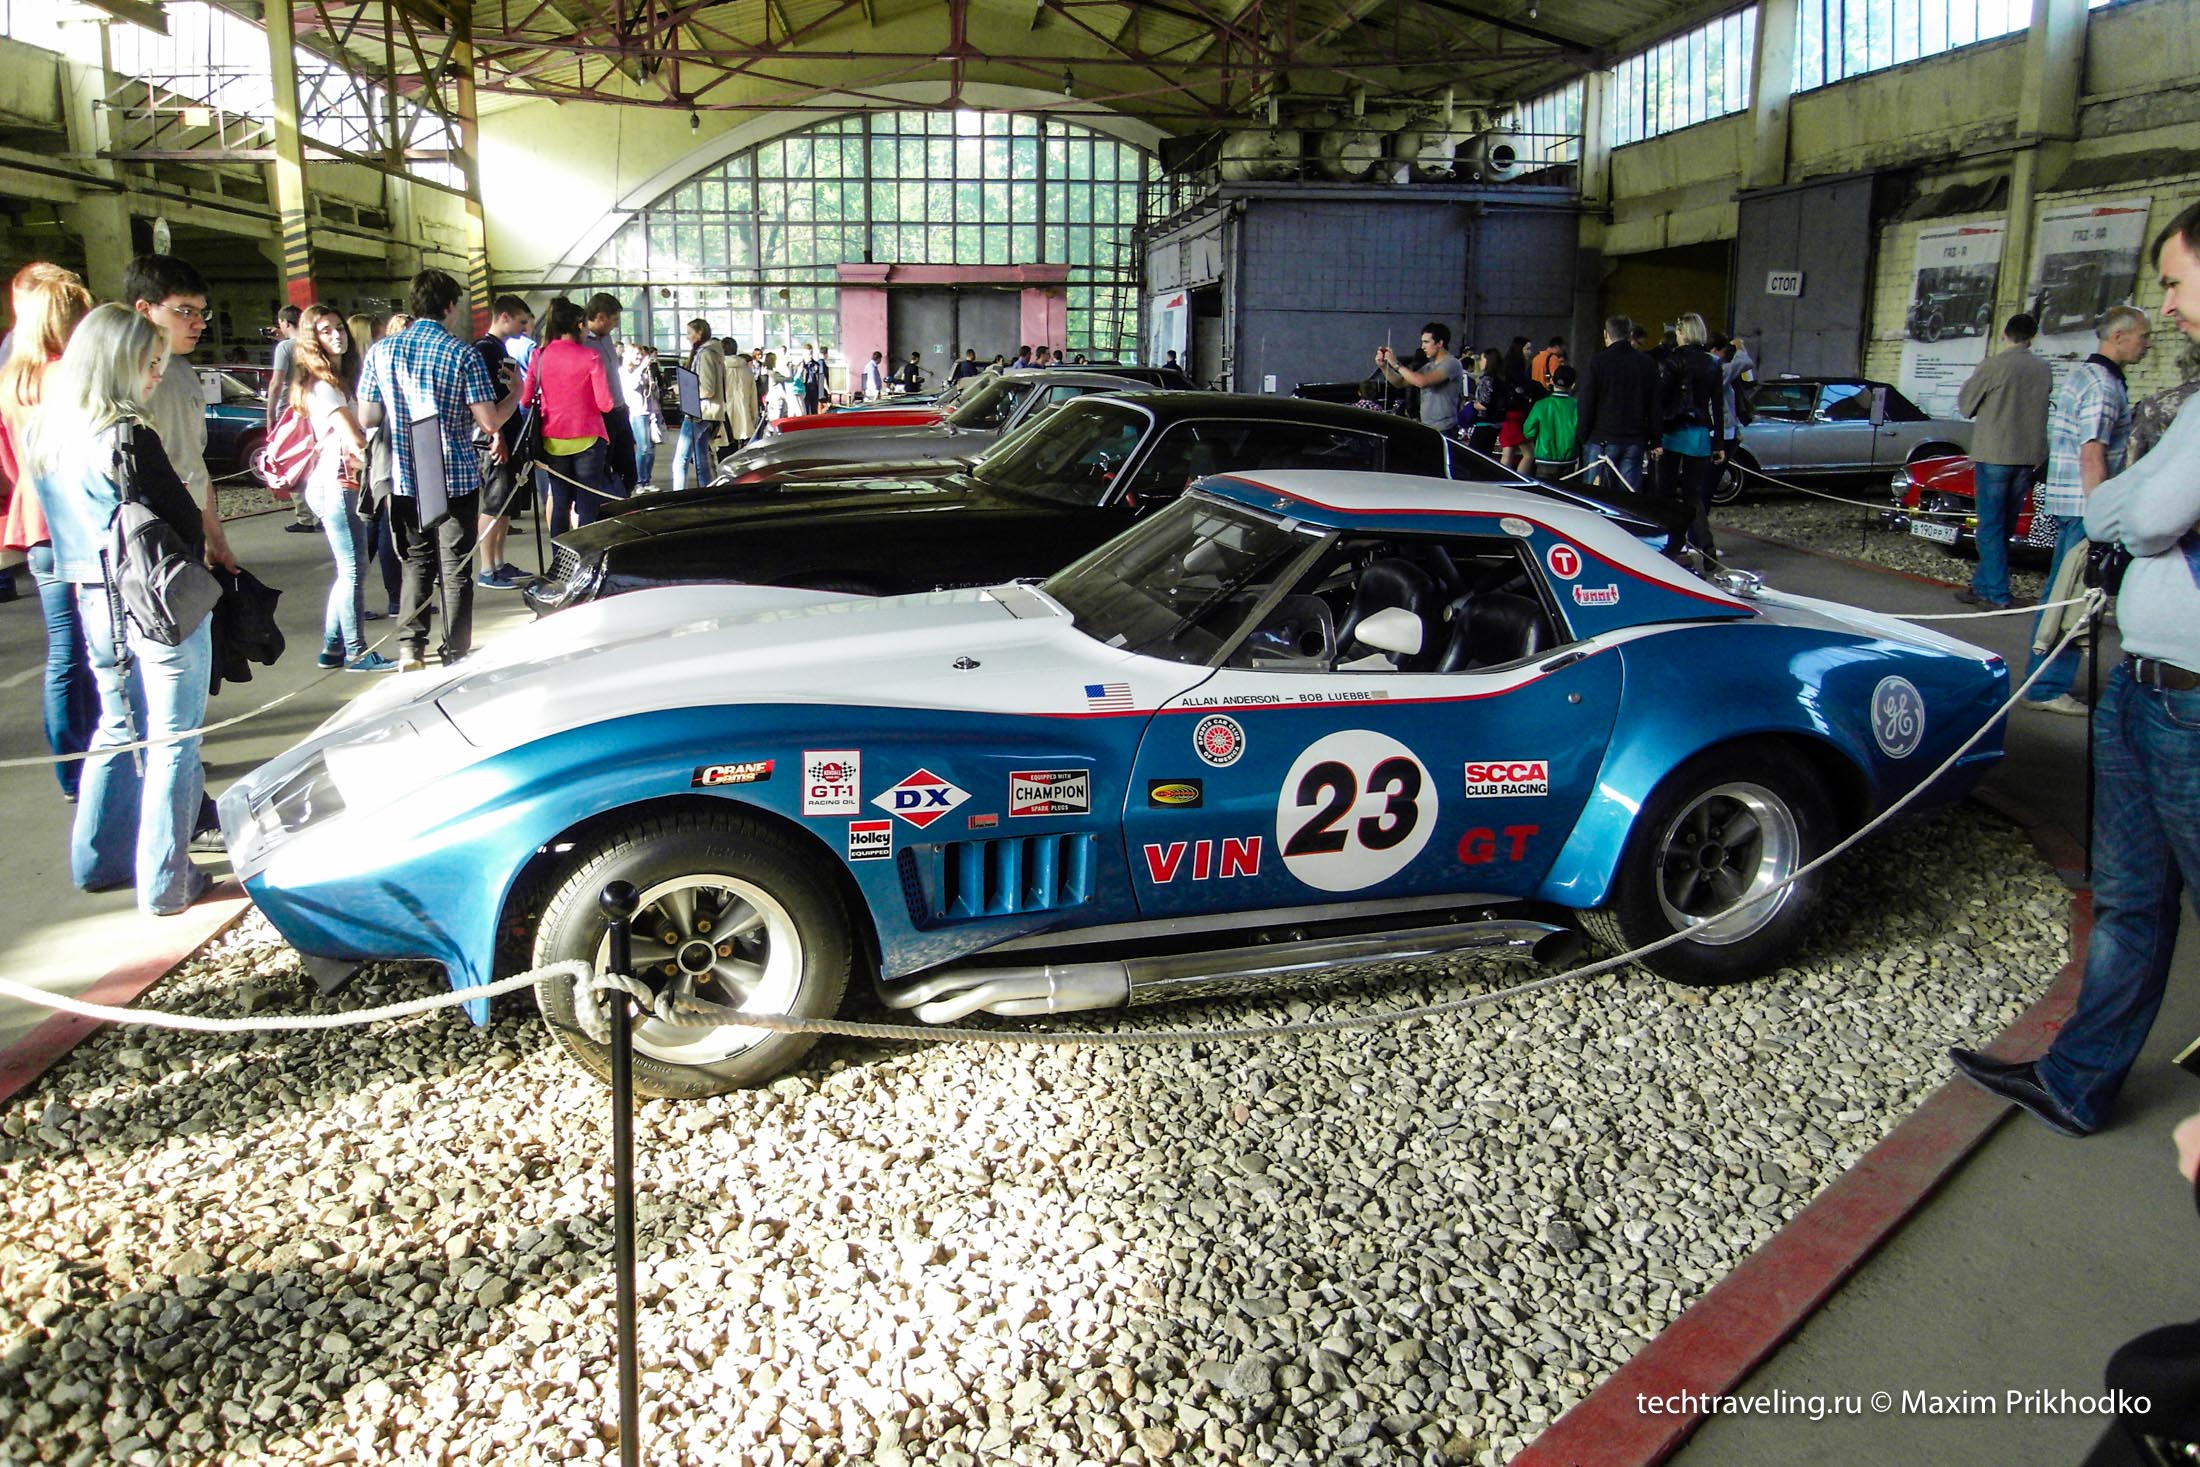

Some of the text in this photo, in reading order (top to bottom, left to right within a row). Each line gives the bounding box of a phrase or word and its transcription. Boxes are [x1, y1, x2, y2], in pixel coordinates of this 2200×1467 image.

[1772, 277, 1797, 291] СТОП
[1555, 552, 1572, 572] T
[1182, 697, 1217, 707] ALLAN
[1223, 695, 1280, 705] ANDERSON
[1300, 693, 1323, 702] BOB
[1328, 692, 1372, 701] LUEBBE
[1198, 721, 1213, 746] SPORTS
[1229, 724, 1241, 741] CLUB
[1203, 746, 1240, 762] OF AMERICA
[702, 762, 767, 786] CRANE
[1030, 773, 1057, 781] EQUIPPED
[1466, 763, 1546, 783] SCCA
[811, 785, 853, 798] GT-1
[1016, 785, 1085, 800] CHAMPION
[1467, 783, 1547, 795] CLUB RACING
[894, 787, 952, 809] DX
[1283, 755, 1422, 857] 23
[851, 832, 890, 846] Holley
[1457, 824, 1539, 864] GT
[851, 849, 889, 857] EQUIPPED
[1143, 836, 1263, 884] VIN
